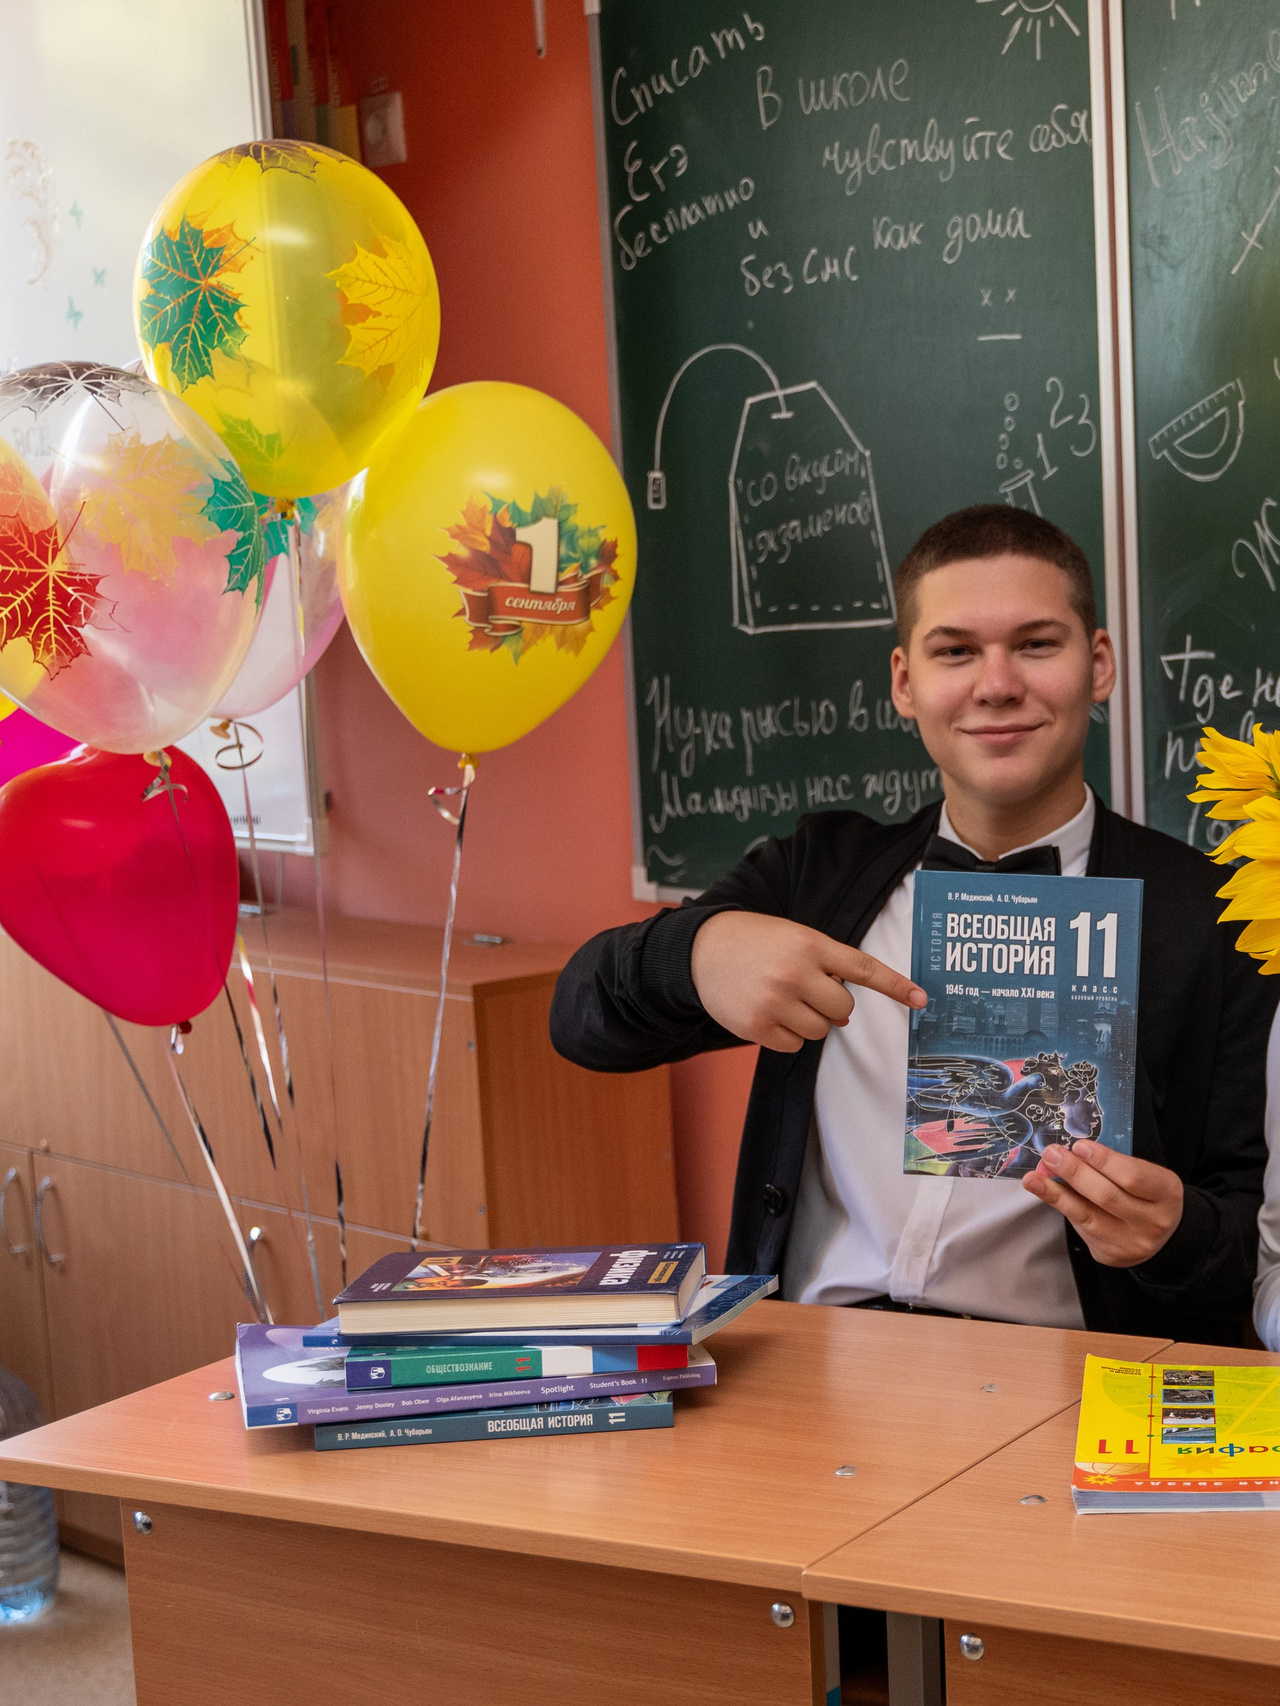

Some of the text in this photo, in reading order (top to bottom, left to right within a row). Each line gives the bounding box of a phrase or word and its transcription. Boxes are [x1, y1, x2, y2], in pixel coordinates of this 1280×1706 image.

[611, 12, 765, 126] Списать
[799, 58, 912, 116] школе
[822, 103, 1092, 196] чувствуйте себя
[613, 176, 756, 271] бесплатно
[747, 218, 769, 240] и
[942, 206, 1032, 265] дома
[739, 253, 795, 297] без
[747, 448, 859, 507] со вкусом
[755, 490, 872, 564] экзаменов
[515, 516, 559, 595] 1
[504, 596, 576, 615] сентября
[805, 773, 855, 809] нас
[930, 912, 943, 971] ИСТОРИЯ
[946, 913, 1056, 944] ВСЕОБЩАЯ
[1069, 911, 1118, 978] 11
[945, 941, 1056, 976] ИСТОРИЯ
[945, 984, 964, 995] 1945
[965, 986, 979, 998] год
[992, 987, 1019, 997] начало
[1020, 987, 1035, 998] XXI
[1036, 989, 1055, 999] века
[426, 1361, 493, 1374] ОБЩЕСТВОЗНАНИЕ
[516, 1357, 531, 1373] 11
[355, 1403, 374, 1412] Jenny
[374, 1401, 395, 1410] Dooley
[450, 1393, 483, 1401] Afanasyeva
[504, 1389, 531, 1397] Mikheeva
[541, 1384, 575, 1395] Spotlight
[589, 1379, 620, 1389] Student's
[621, 1378, 637, 1386] Book
[338, 1433, 344, 1441] В.
[404, 1428, 432, 1438] Чубарьян
[487, 1415, 545, 1434] ВСЕОБЩАЯ
[548, 1413, 594, 1429] ИСТОРИЯ
[608, 1412, 626, 1425] 11
[1098, 1438, 1140, 1455] 11
[1134, 1479, 1223, 1487] ЗВЕЗДА
